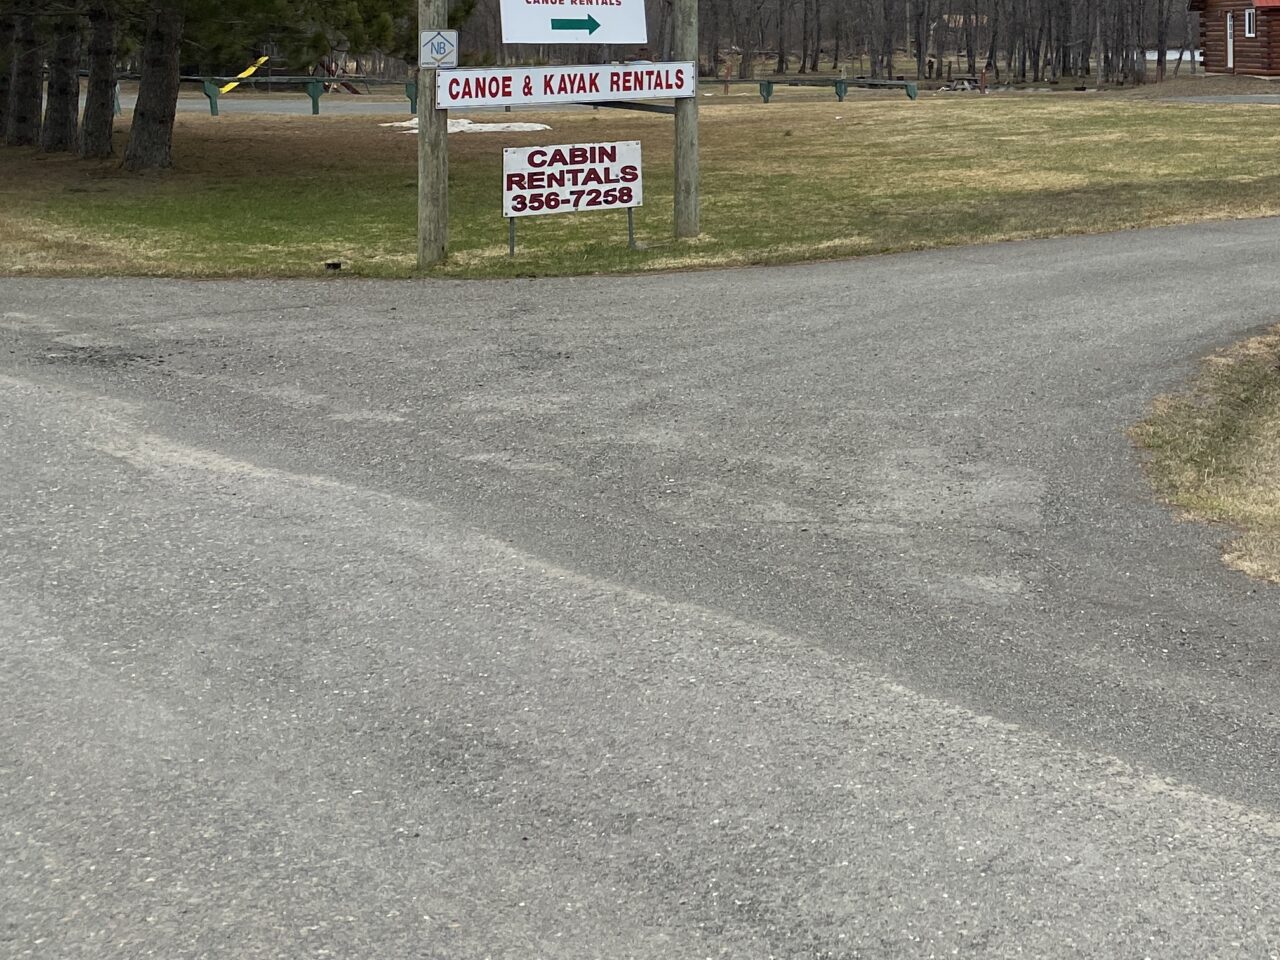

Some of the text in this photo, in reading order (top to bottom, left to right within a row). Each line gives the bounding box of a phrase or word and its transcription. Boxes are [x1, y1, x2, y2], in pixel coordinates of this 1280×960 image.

[430, 41, 447, 56] NB
[448, 68, 685, 101] CANOE & KAYAK RENTALS
[527, 145, 617, 169] CABIN
[506, 165, 639, 192] RENTALS
[511, 186, 633, 213] 356-7258
